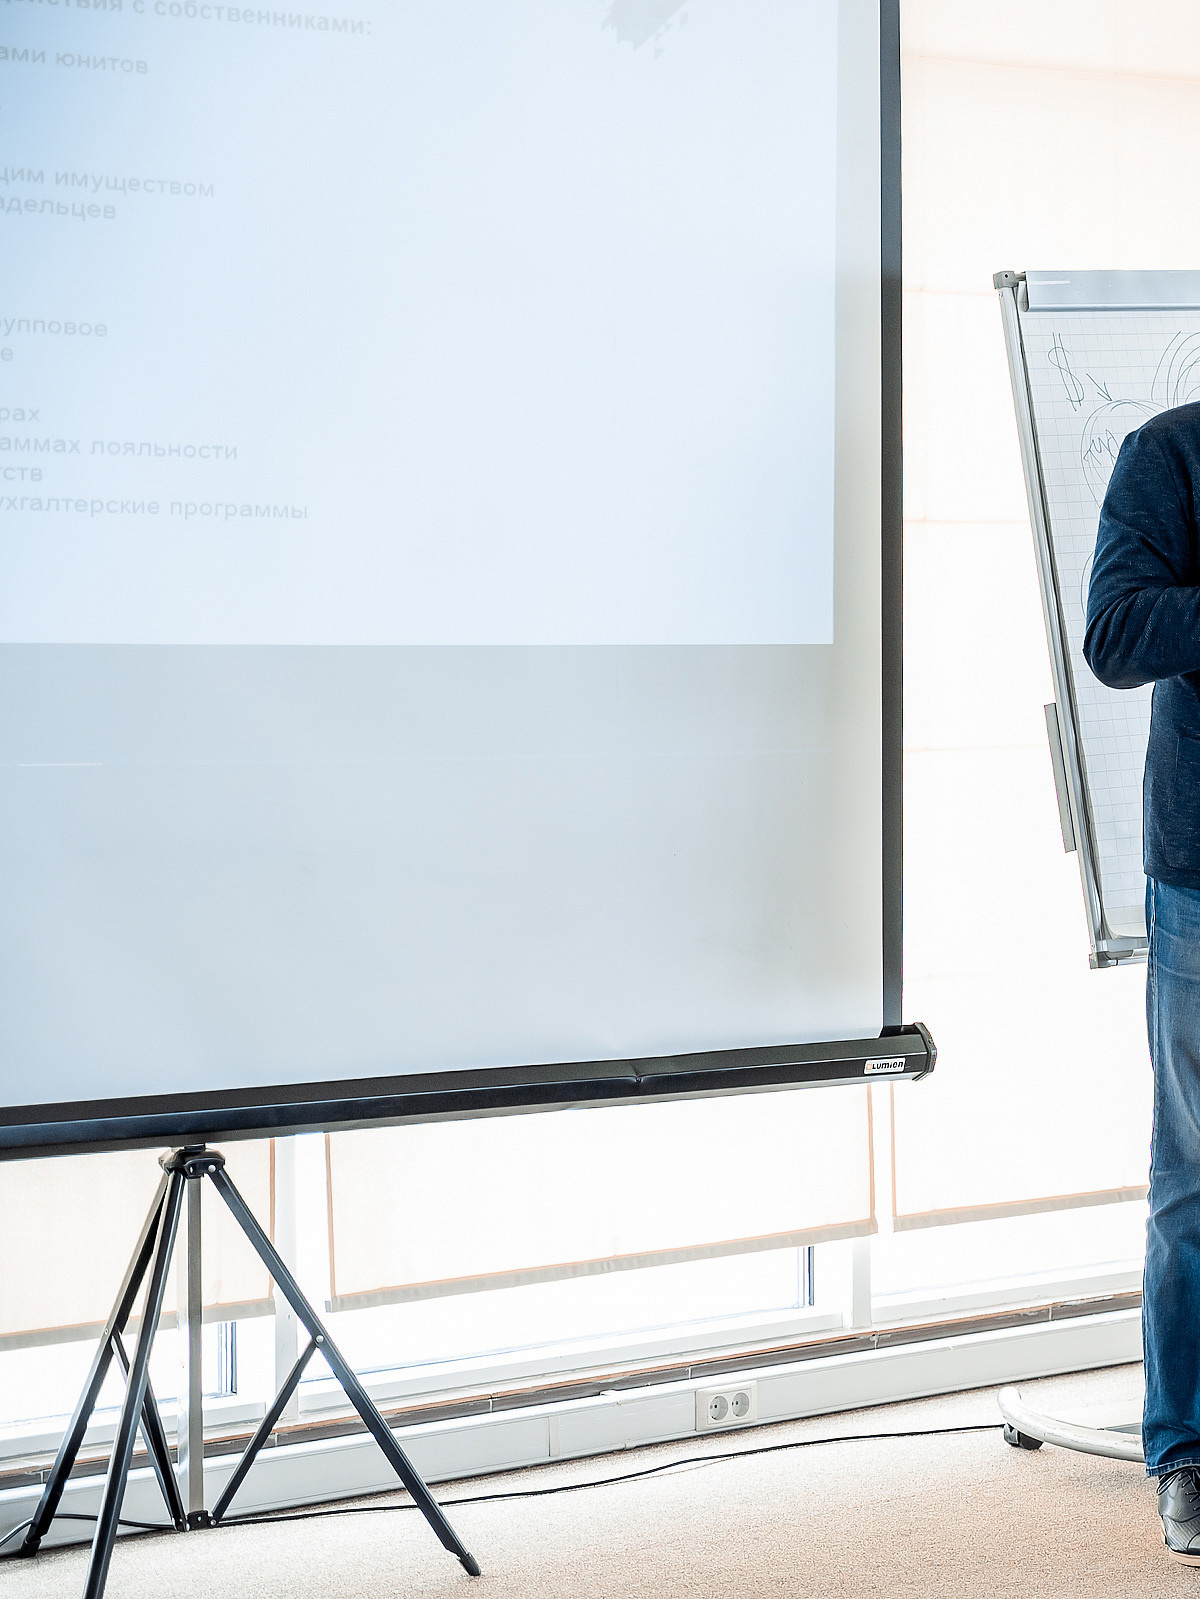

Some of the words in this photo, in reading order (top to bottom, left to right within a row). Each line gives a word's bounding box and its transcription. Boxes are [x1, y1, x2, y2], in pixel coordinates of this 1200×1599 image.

[154, 1, 372, 34] собственниками:
[56, 51, 148, 75] юнитов
[55, 172, 215, 198] имуществом
[0, 318, 108, 337] упповое
[90, 440, 238, 461] лояльности
[0, 465, 43, 482] ств
[169, 501, 308, 521] программы
